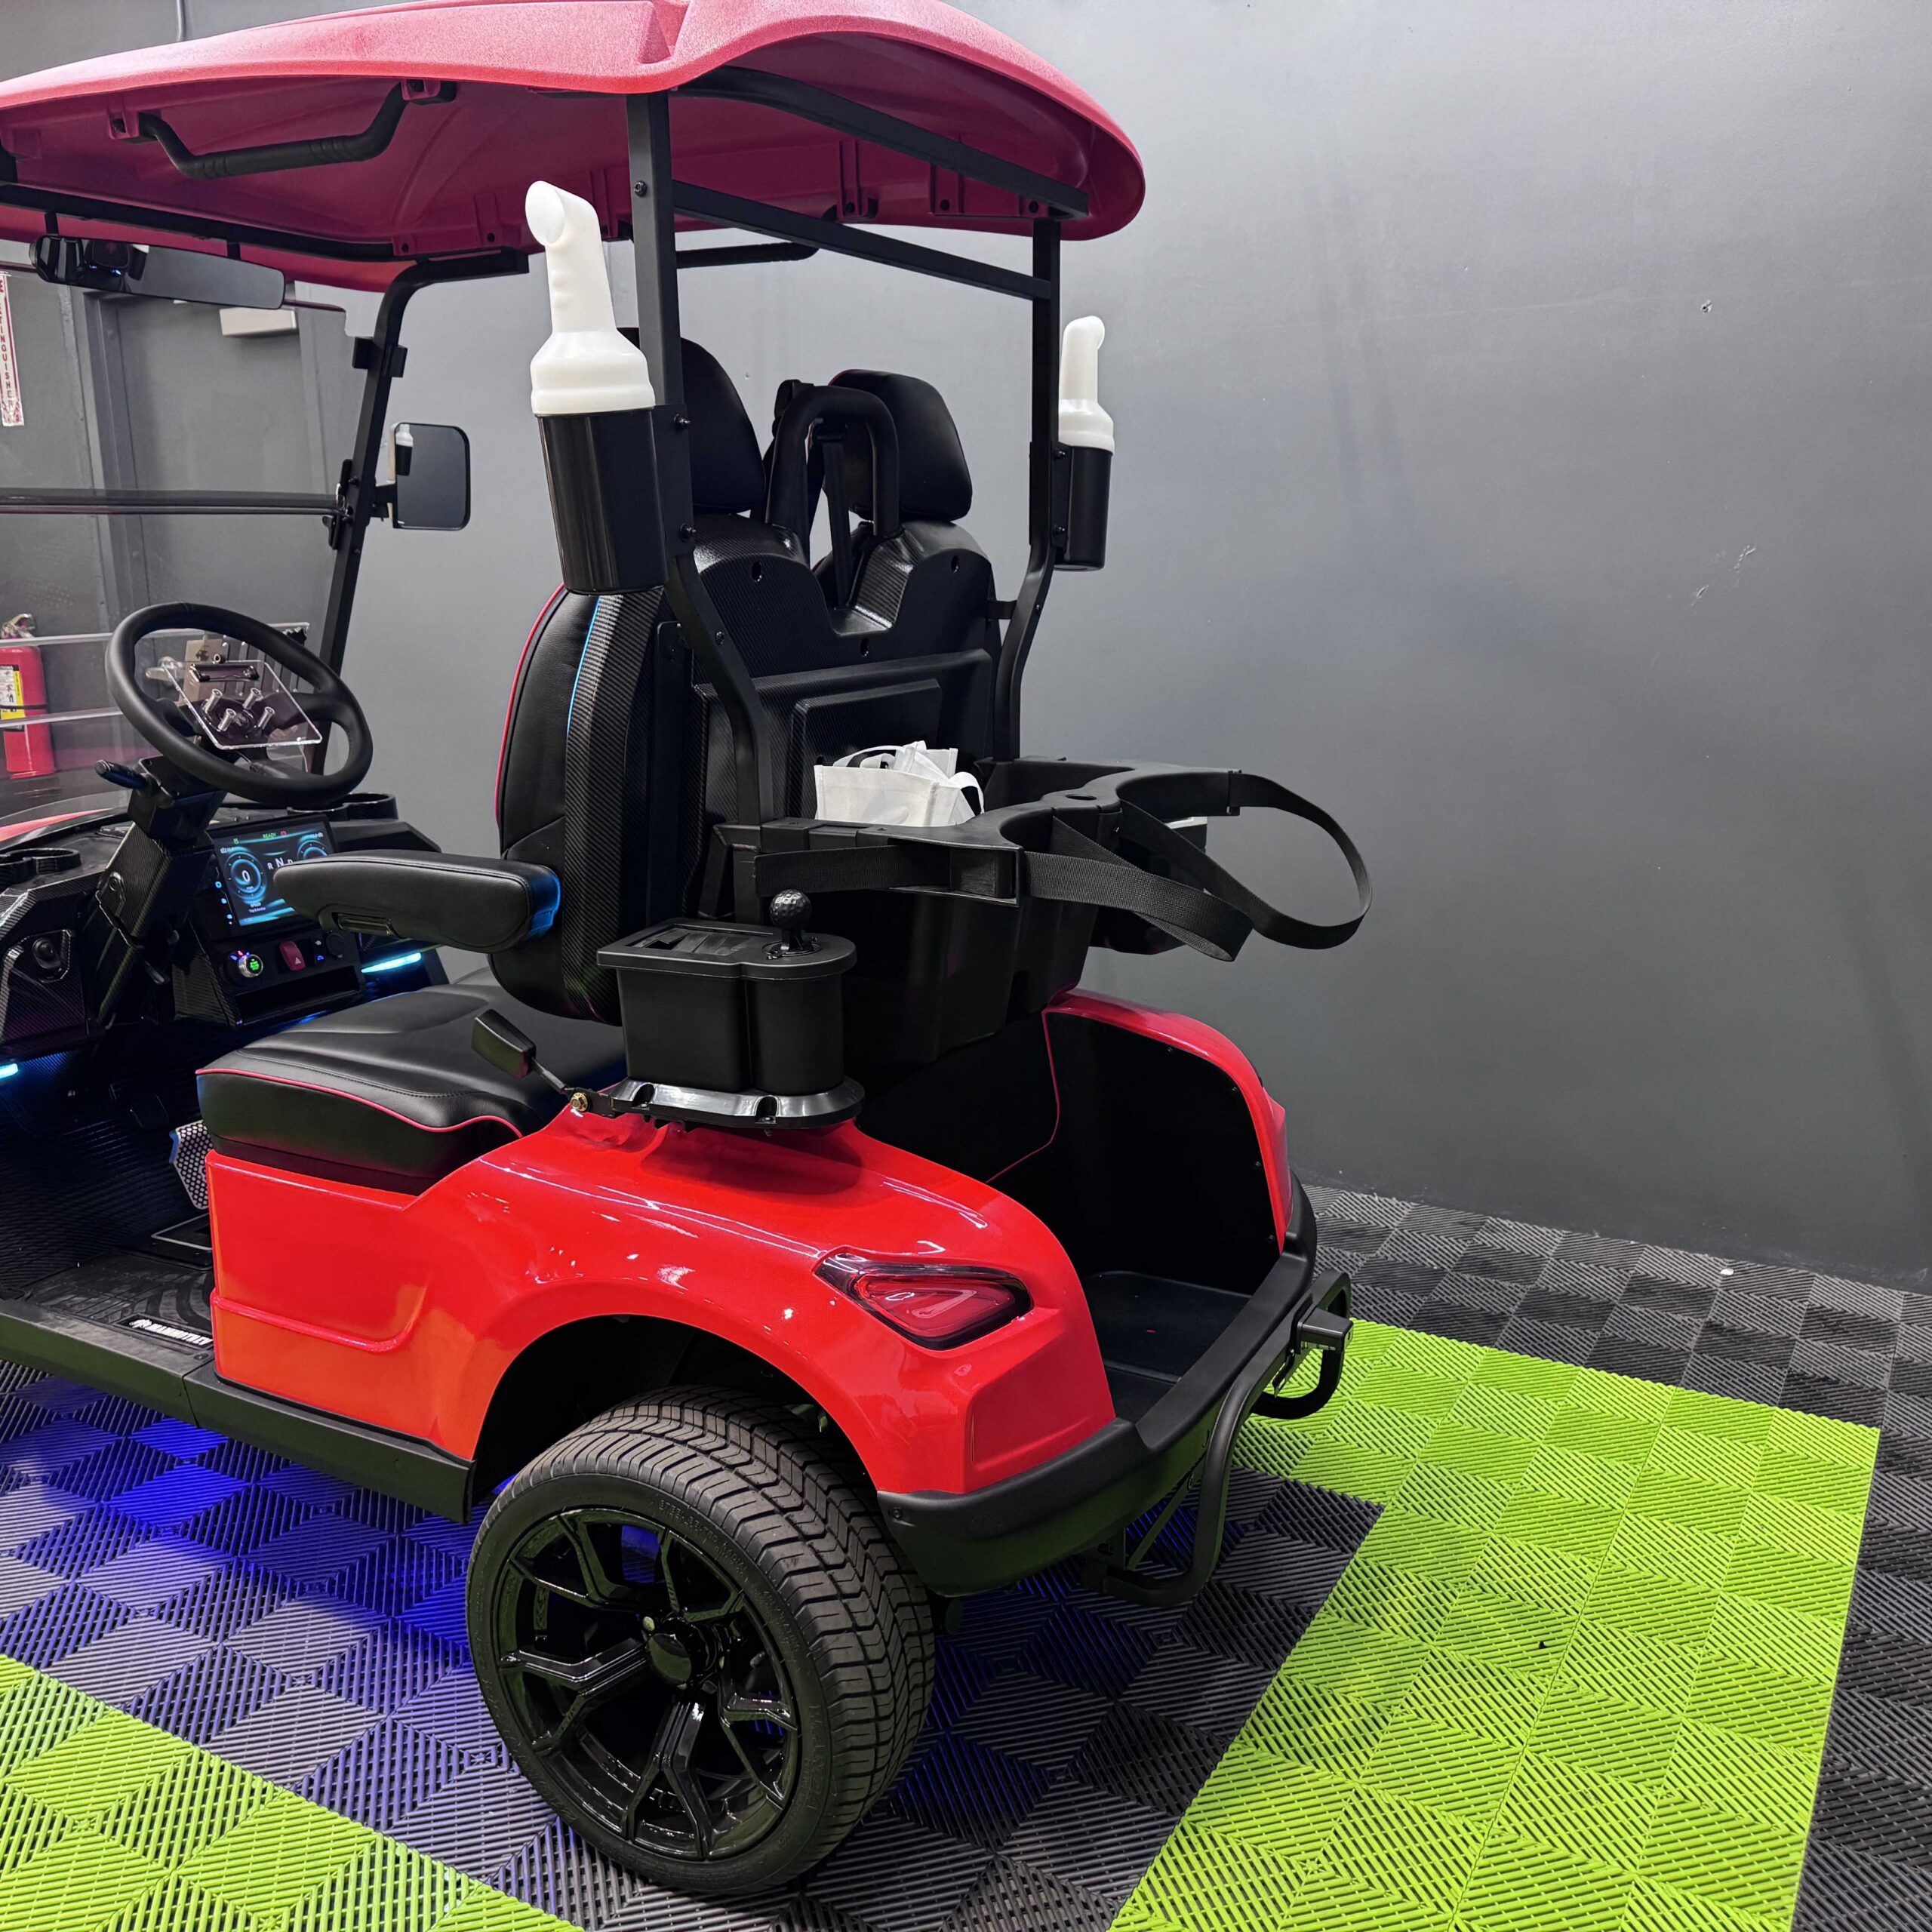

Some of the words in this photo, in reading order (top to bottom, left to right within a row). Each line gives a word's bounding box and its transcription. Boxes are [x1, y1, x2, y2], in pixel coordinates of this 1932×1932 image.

[0, 303, 14, 408] TINGUISHER
[275, 857, 284, 867] N
[242, 870, 250, 882] 0
